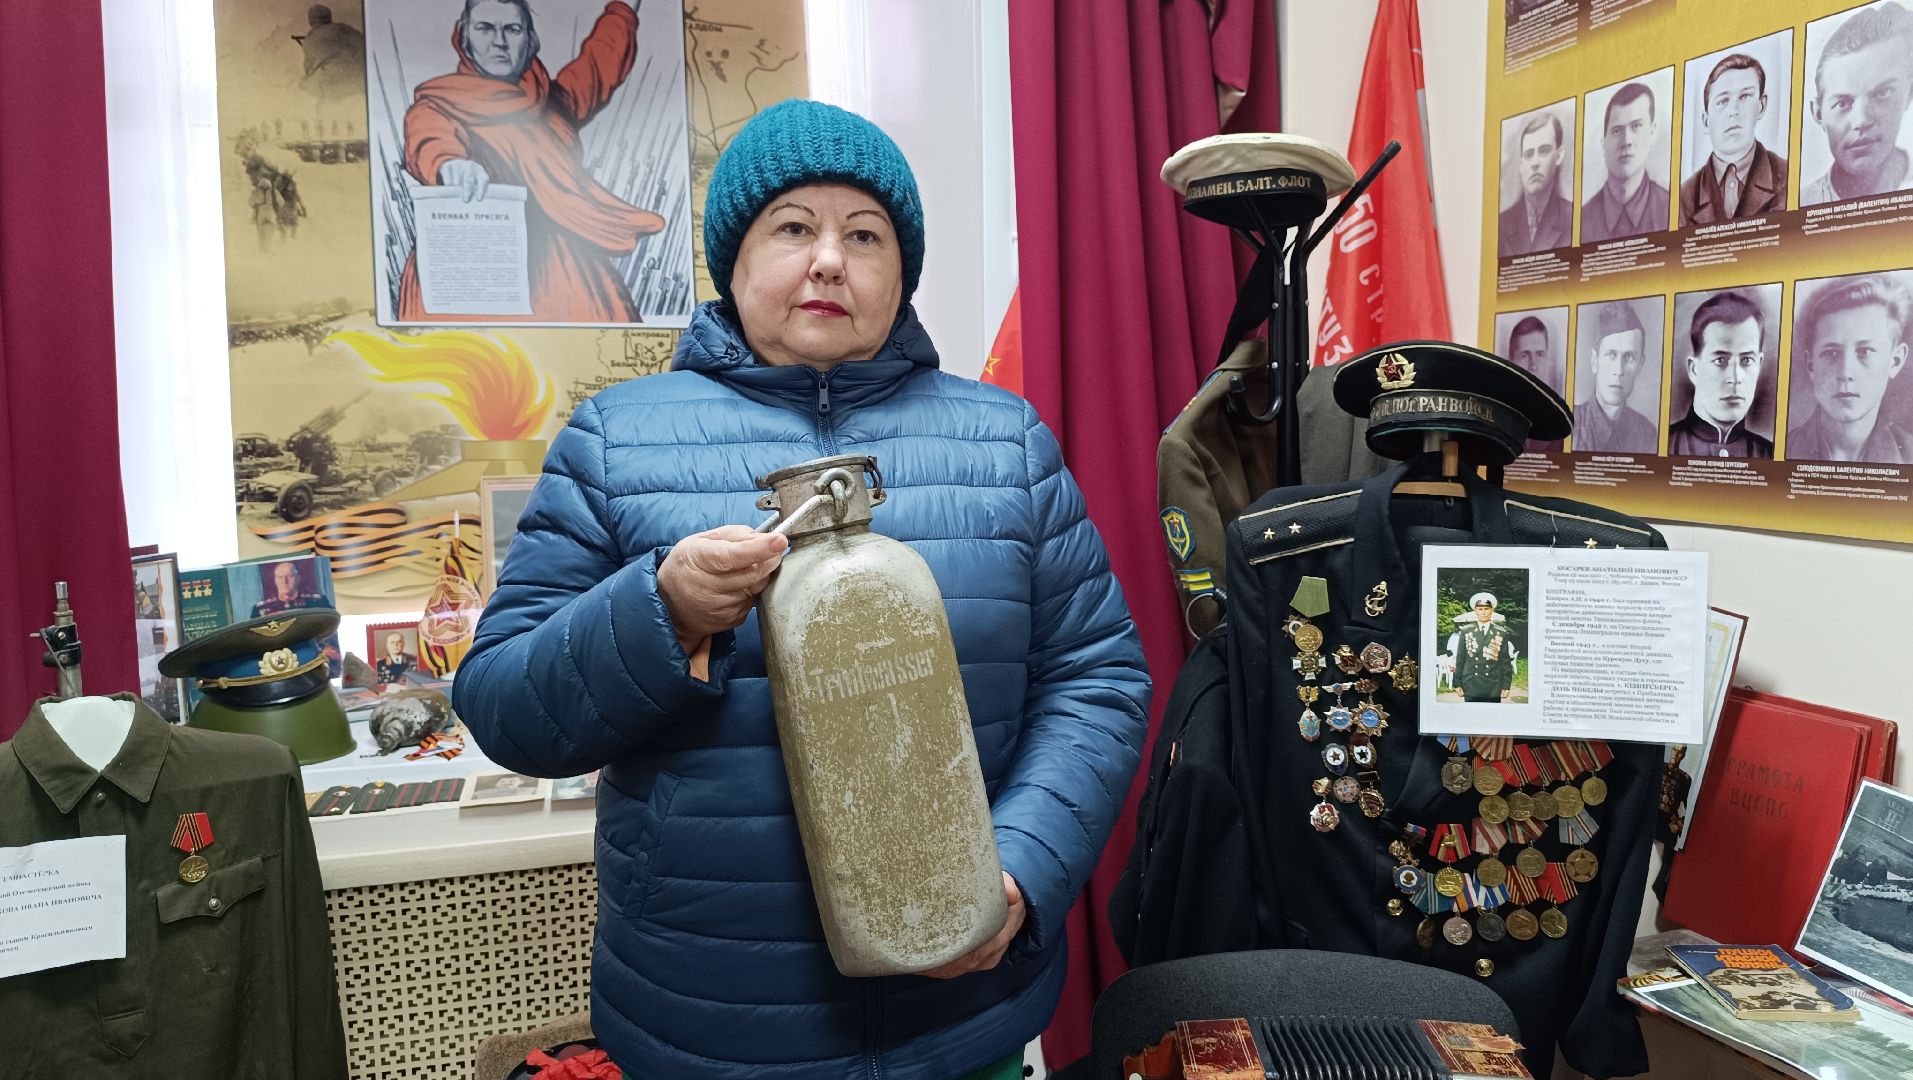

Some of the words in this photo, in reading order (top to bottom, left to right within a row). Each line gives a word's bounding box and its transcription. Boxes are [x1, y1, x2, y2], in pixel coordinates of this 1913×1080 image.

[684, 23, 723, 33] АЛДОМ
[1236, 176, 1276, 193] БАЛТ.
[1278, 175, 1312, 189] ФЛОТ
[1726, 757, 1805, 795] ГРАМОТА
